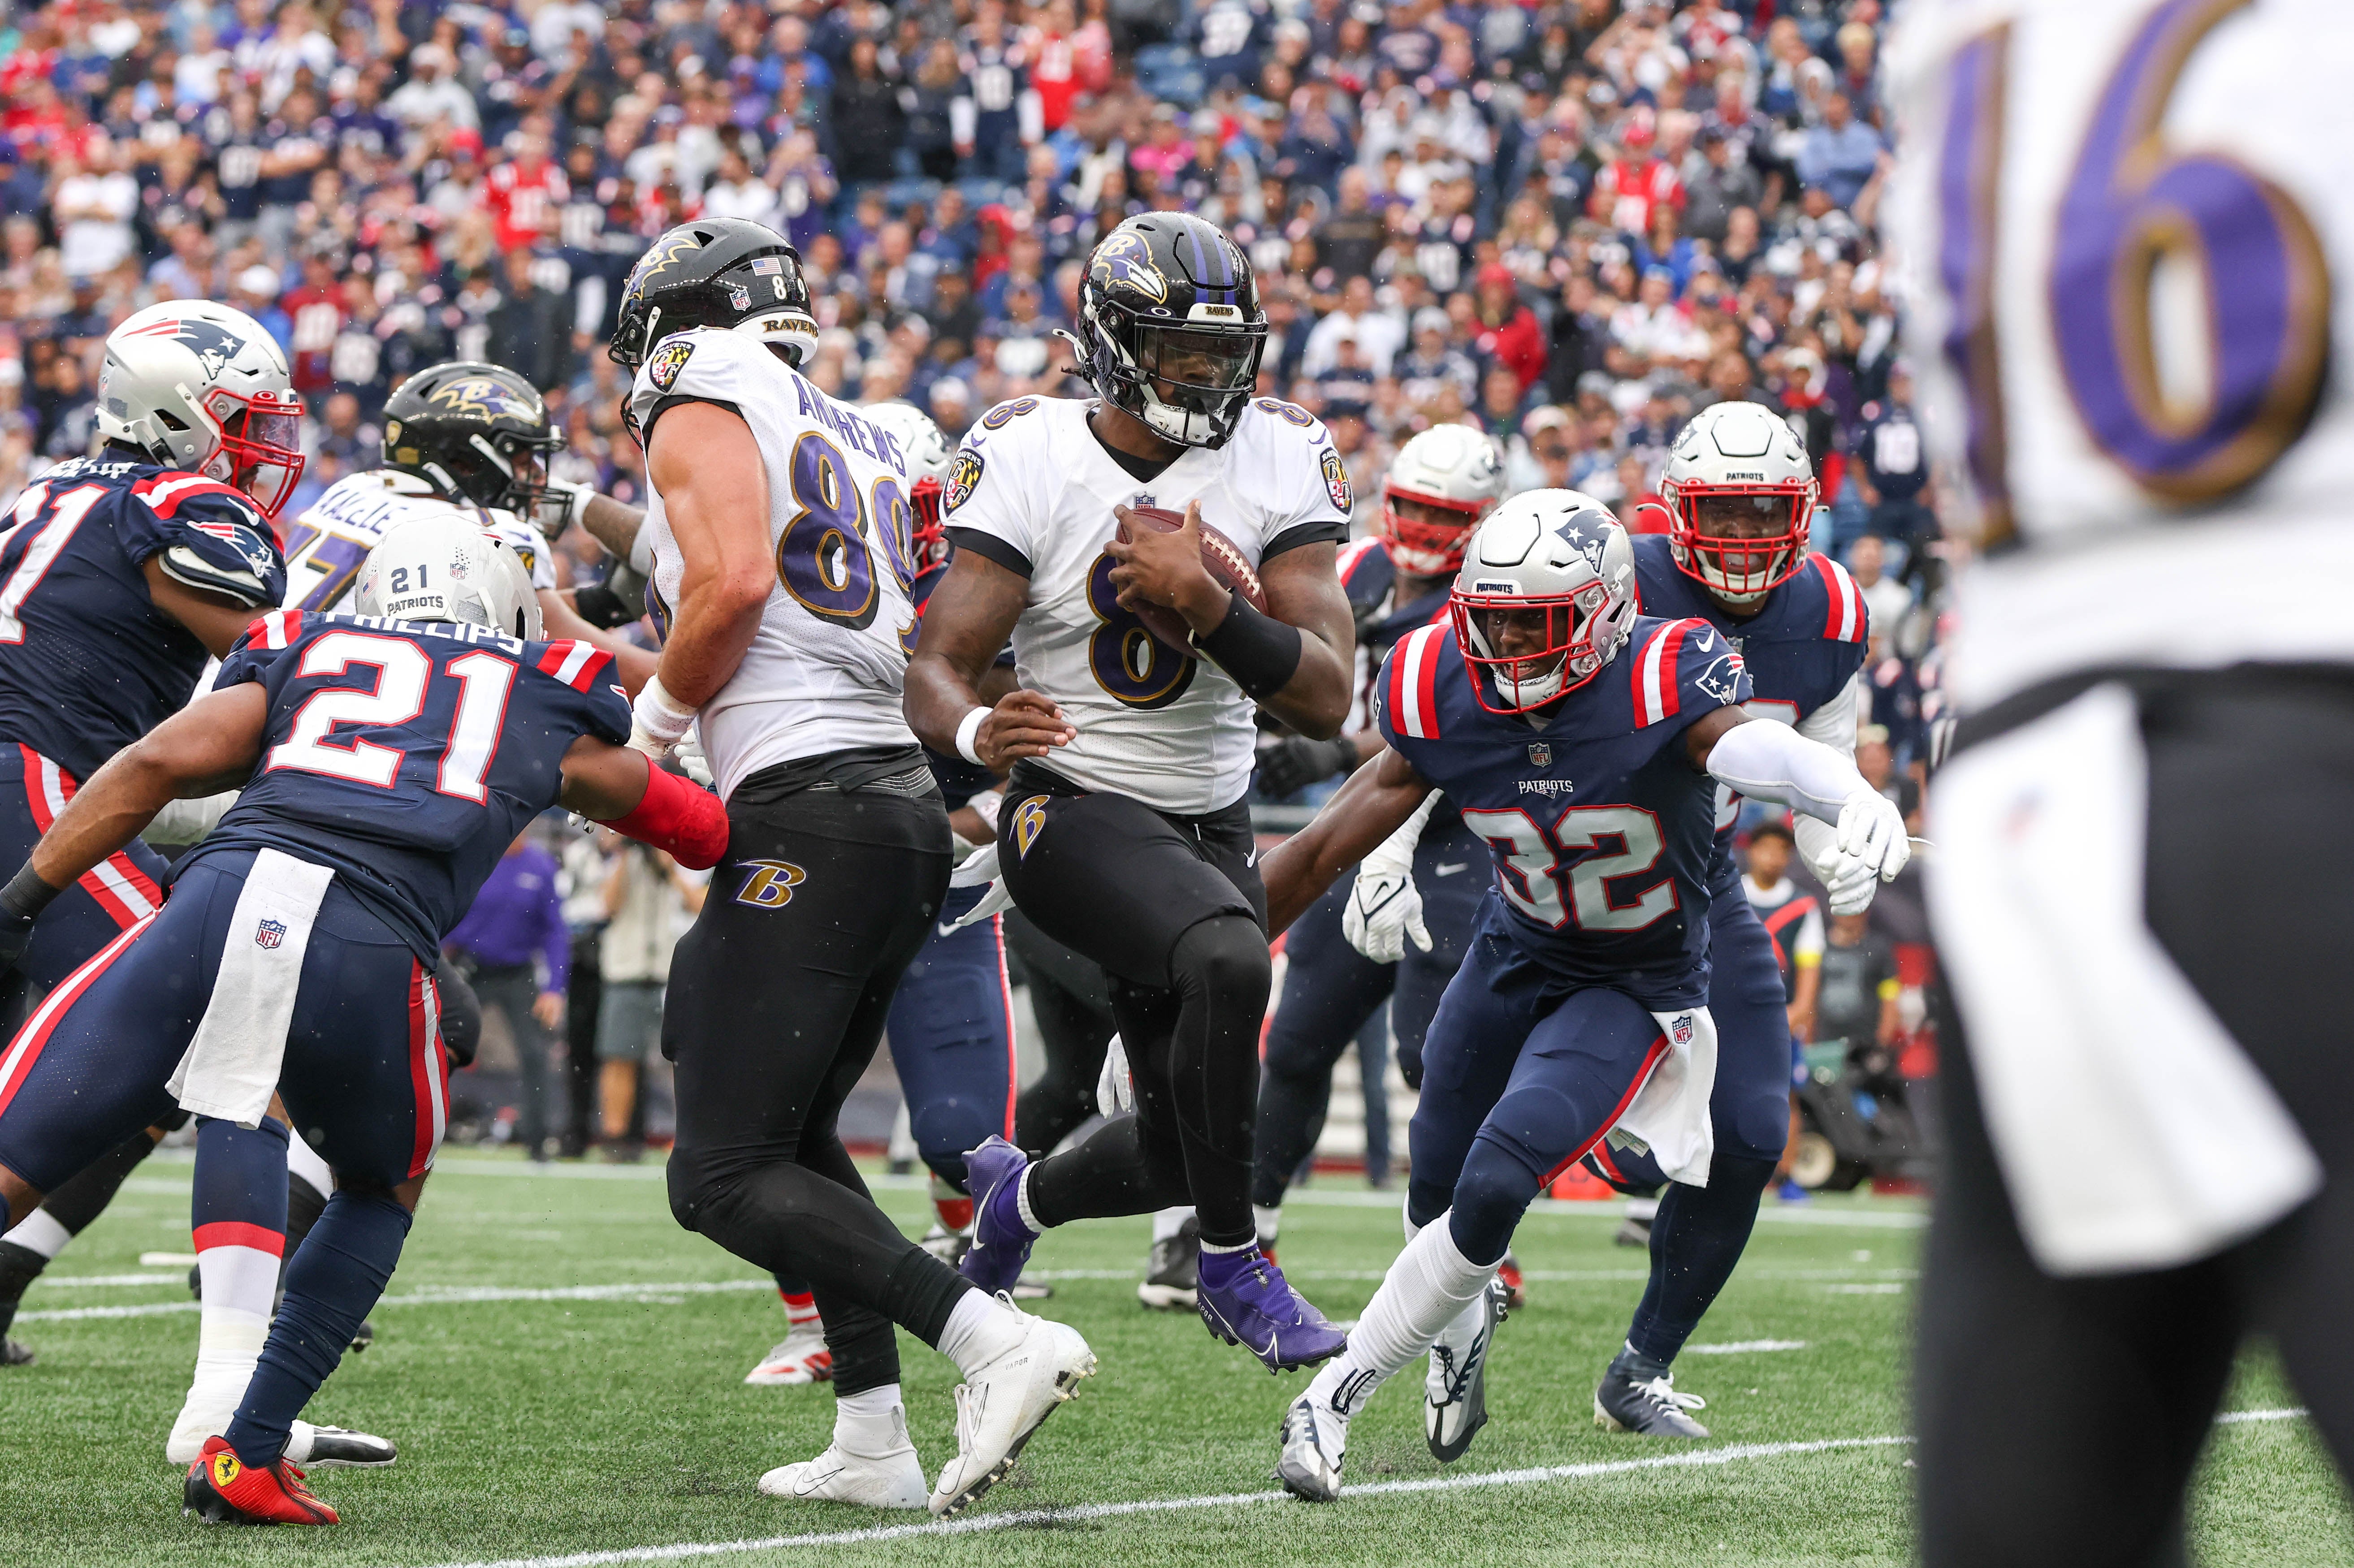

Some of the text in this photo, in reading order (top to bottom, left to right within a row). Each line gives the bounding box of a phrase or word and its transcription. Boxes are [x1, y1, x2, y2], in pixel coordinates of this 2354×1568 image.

[1937, 0, 2331, 549] 16
[734, 297, 750, 308] NFL
[1205, 306, 1233, 316] RAVENS
[763, 319, 819, 338] RAVENS
[658, 342, 692, 353] RAVENS
[983, 398, 1039, 430] 8
[1255, 399, 1313, 427] 8
[791, 374, 906, 478] ANREWS
[957, 450, 982, 466] RAVENS
[1727, 473, 1764, 482] PATRIOTS
[776, 430, 917, 655] 89
[391, 565, 427, 594] 21
[451, 569, 464, 578] NFL
[1476, 583, 1513, 594] PATRIOTS
[387, 596, 443, 616] PATRIOTS
[1086, 552, 1197, 709] 8
[265, 629, 520, 806] 21
[1533, 754, 1549, 763] NFL
[1518, 780, 1573, 795] PATRIOTS
[1461, 803, 1680, 932] 32
[730, 858, 807, 910] B
[256, 929, 279, 946] NFL
[1675, 1027, 1691, 1042] NFL
[1198, 1300, 1213, 1322] APOR
[1005, 1357, 1028, 1370] VAPOR
